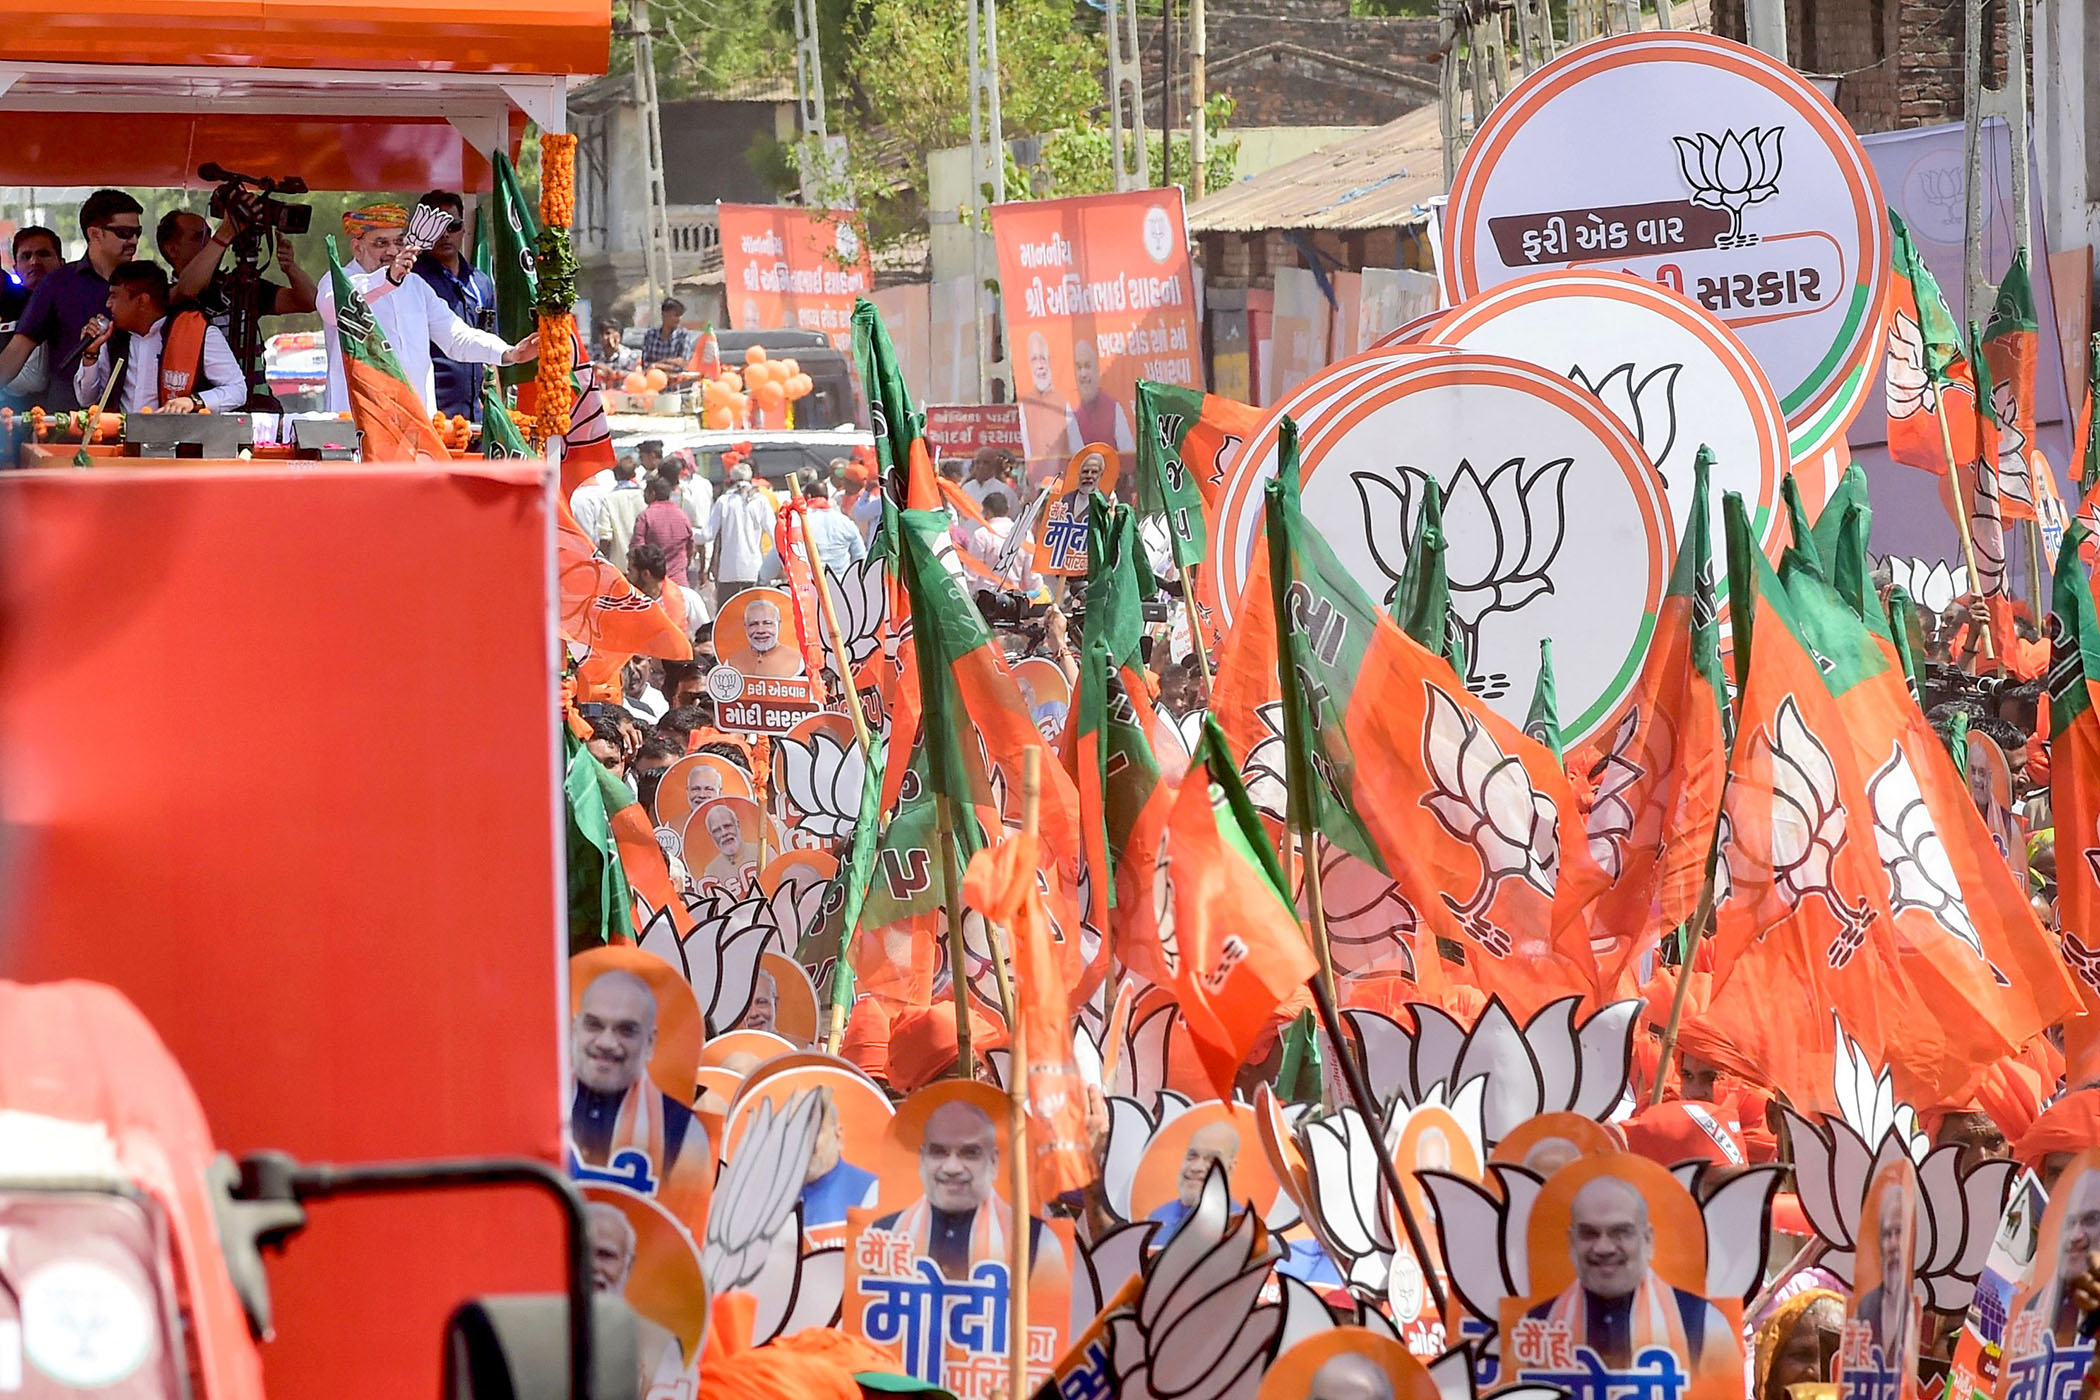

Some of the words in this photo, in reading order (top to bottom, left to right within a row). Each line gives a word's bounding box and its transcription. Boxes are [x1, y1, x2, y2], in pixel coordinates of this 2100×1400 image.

[1522, 216, 1567, 262] ફરી
[1576, 212, 1628, 250] એક
[1636, 216, 1685, 245] વાર
[1697, 267, 1822, 311] સરકાર
[725, 702, 762, 727] મોદી
[861, 1258, 1010, 1386] मोदी
